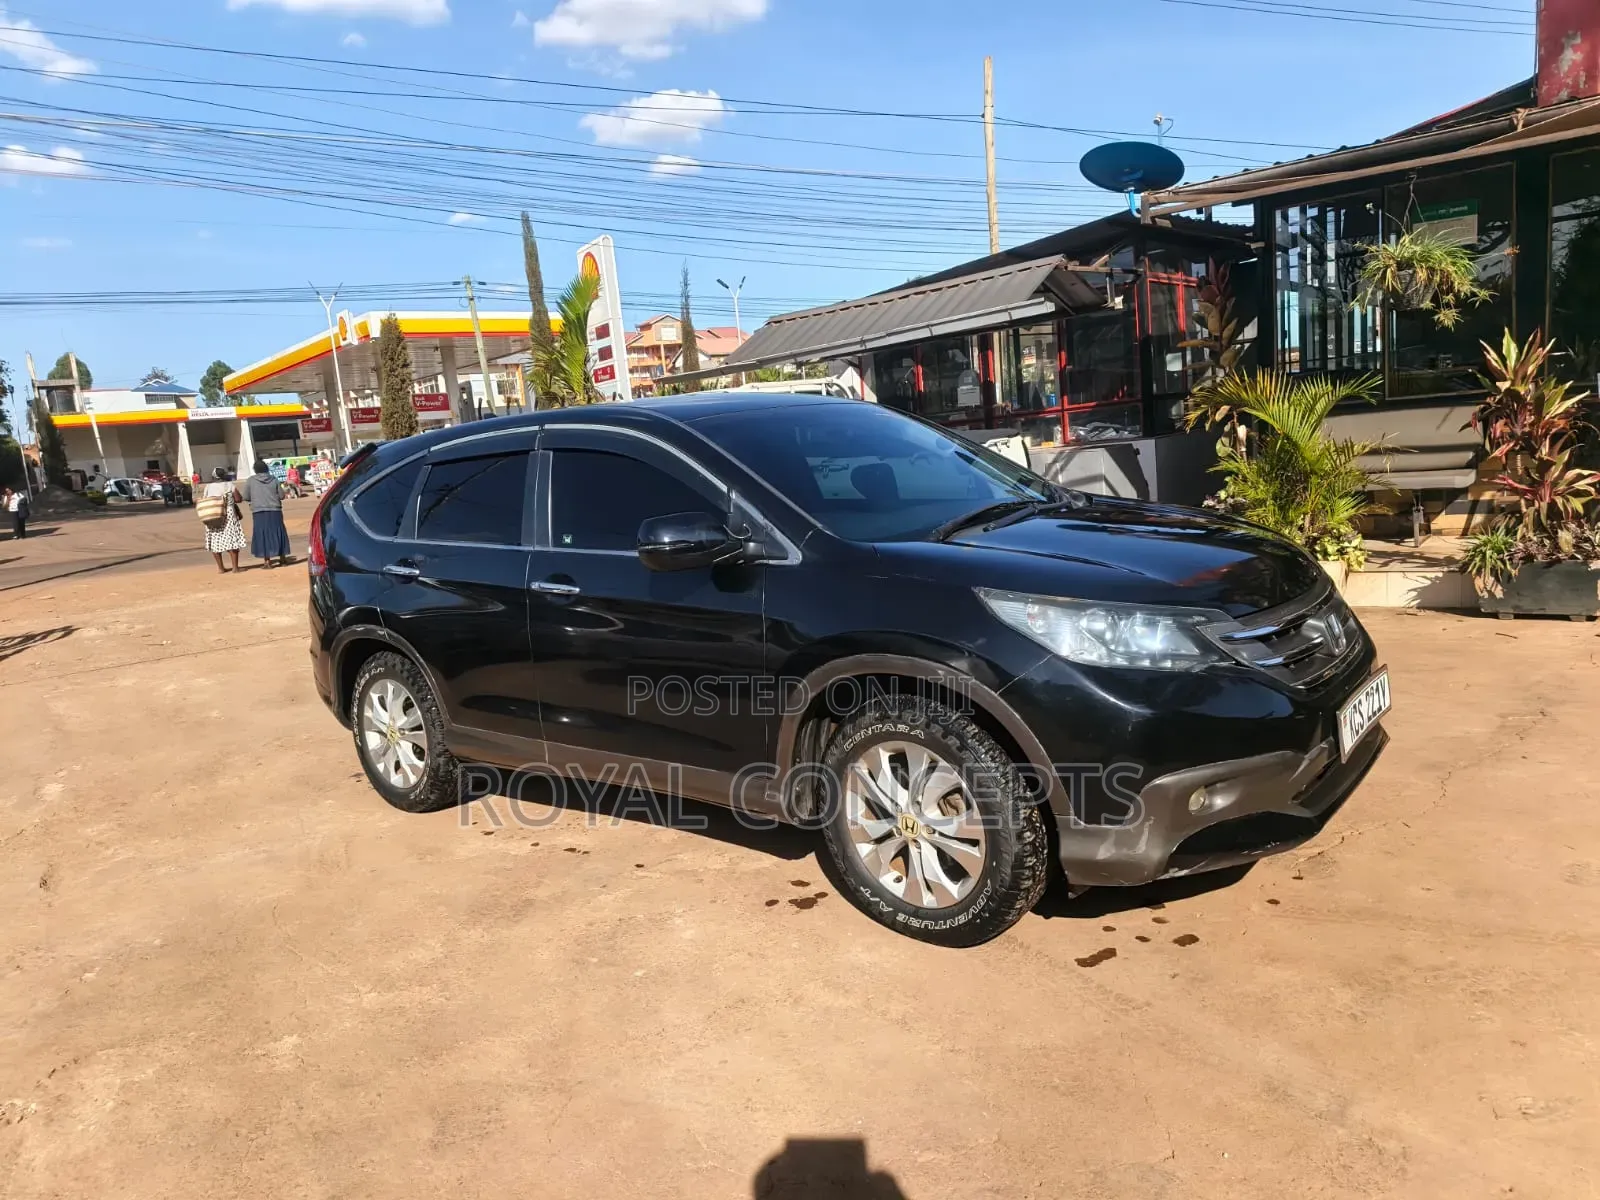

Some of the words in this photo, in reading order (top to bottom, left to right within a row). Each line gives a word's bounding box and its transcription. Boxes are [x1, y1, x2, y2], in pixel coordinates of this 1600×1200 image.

[1348, 698, 1364, 743] KCS
[1365, 676, 1387, 722] 221Y
[843, 723, 924, 752] CENTARA
[859, 886, 894, 912] A/T
[896, 879, 993, 931] ADVENTURE
